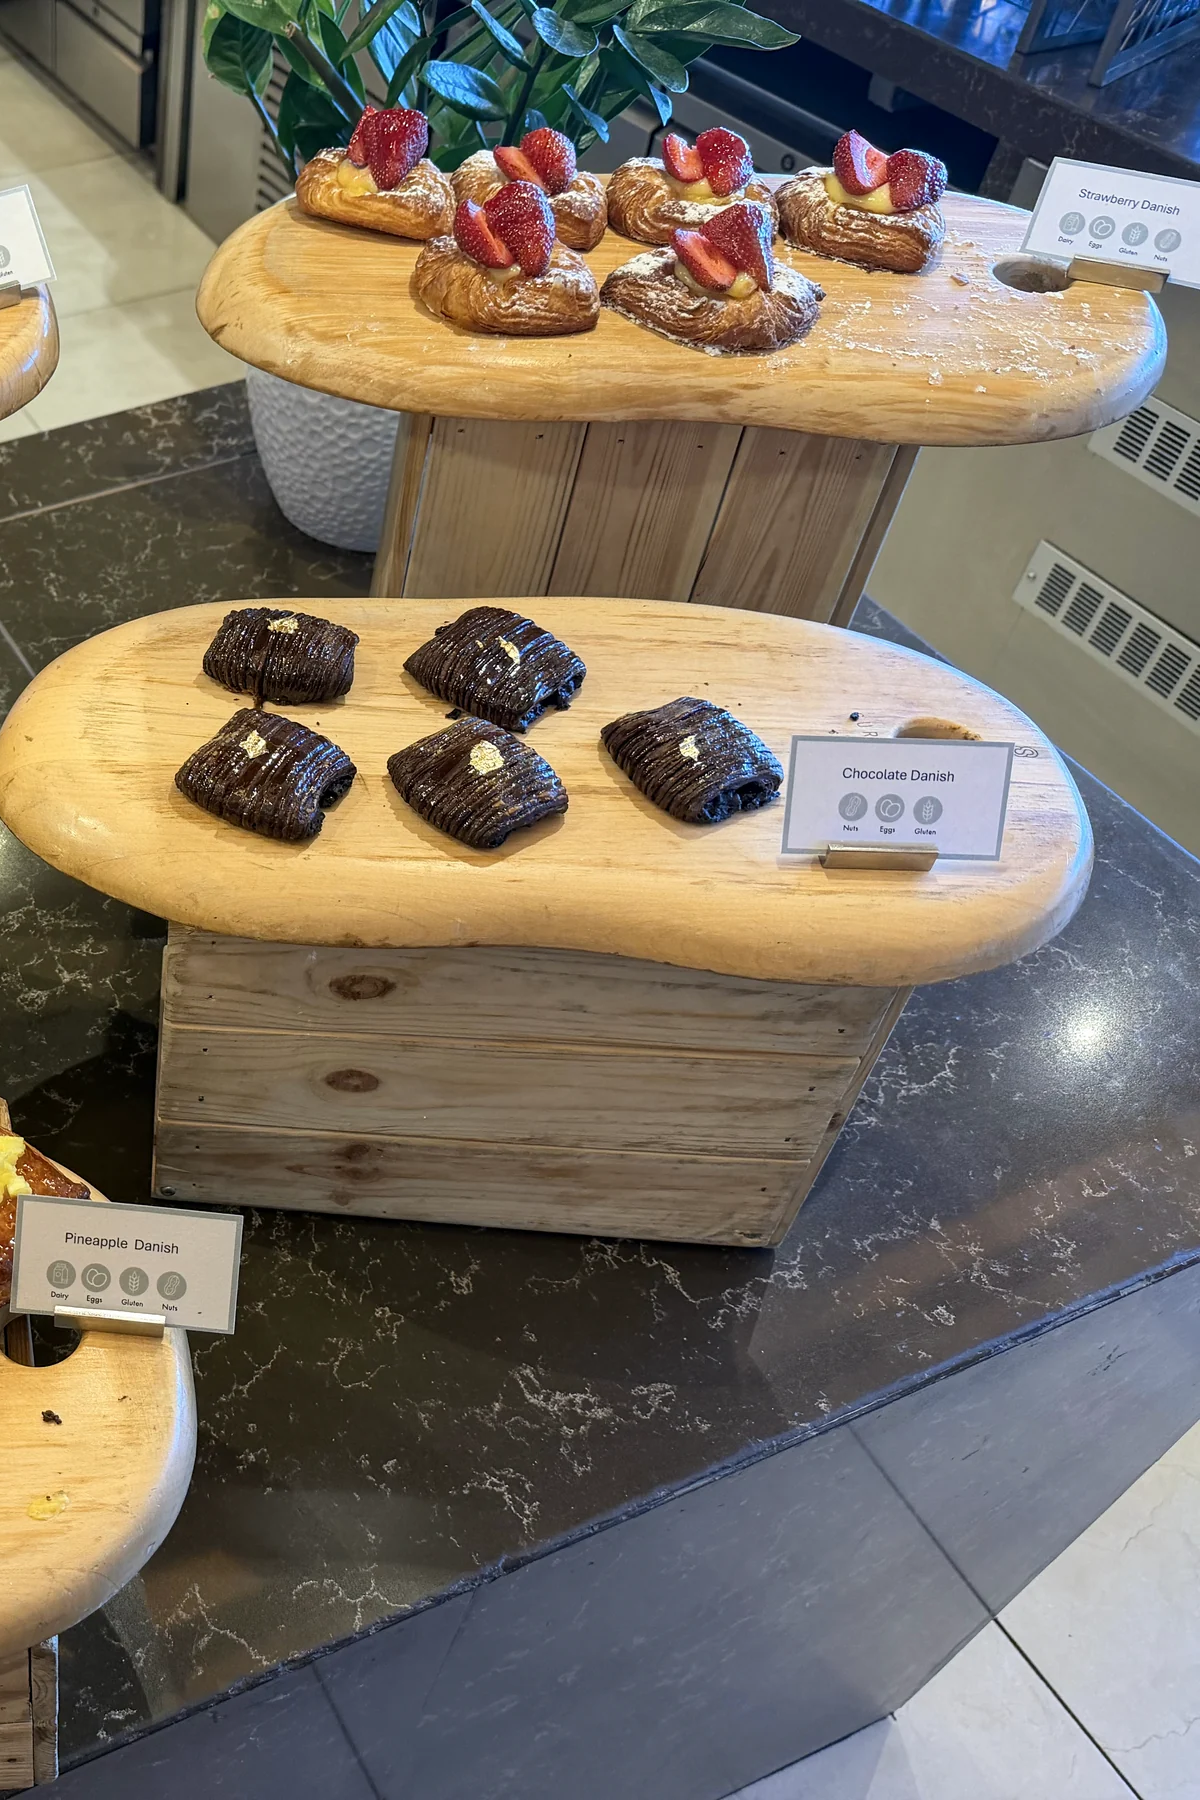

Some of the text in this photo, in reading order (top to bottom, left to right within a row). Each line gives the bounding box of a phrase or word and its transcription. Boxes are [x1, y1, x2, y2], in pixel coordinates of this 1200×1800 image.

[1079, 188, 1181, 216] Strawberry Danish
[1058, 236, 1168, 262] Dairy Eggs Gluten Nuts
[842, 767, 955, 782] Chocolate Danish
[879, 826, 896, 834] Eggs
[914, 828, 937, 836] Gluten
[65, 1232, 179, 1254] Pineapple Danish
[51, 1291, 178, 1312] Dairy Eggs Gluten Nuts
